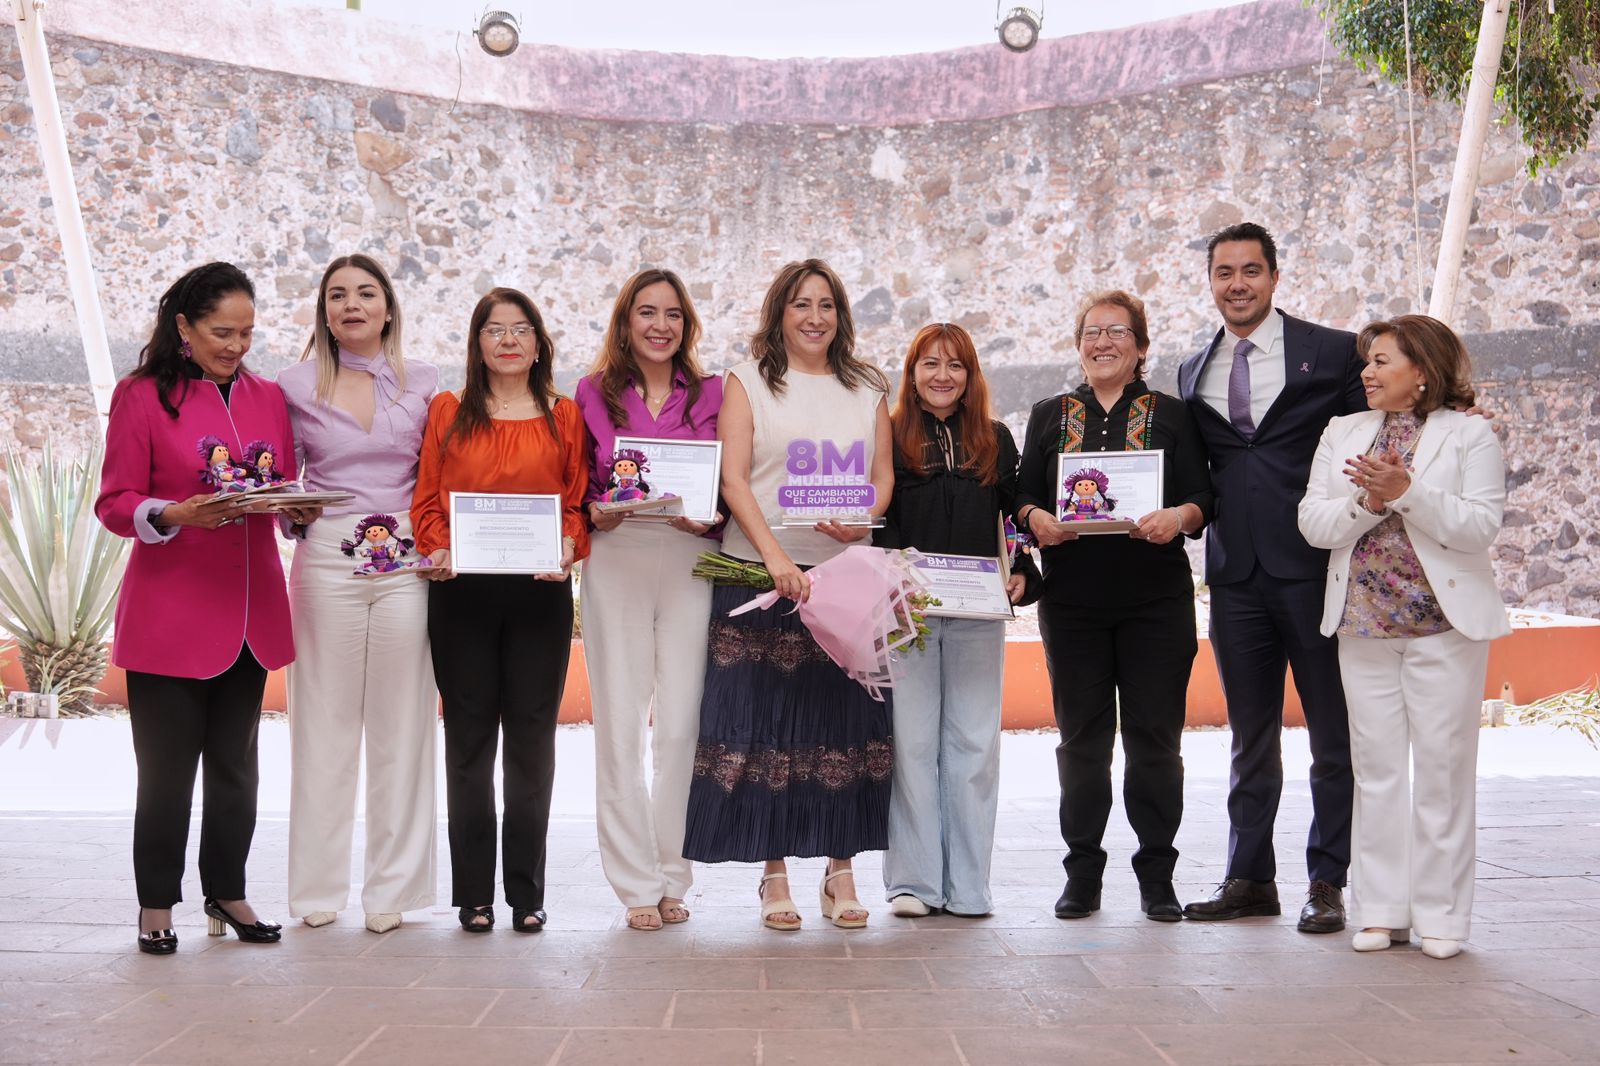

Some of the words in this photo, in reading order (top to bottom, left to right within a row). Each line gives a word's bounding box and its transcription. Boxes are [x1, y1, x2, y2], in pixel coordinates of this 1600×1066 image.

[641, 446, 662, 456] 8M
[786, 439, 865, 476] 8M
[787, 475, 866, 486] MUJERES
[785, 489, 806, 498] QUE
[807, 489, 868, 497] CAMBIARON
[474, 498, 496, 508] 8M
[793, 497, 805, 505] EL
[846, 496, 860, 504] DE
[786, 504, 868, 516] QUERÉTARO
[927, 557, 948, 566] 8M
